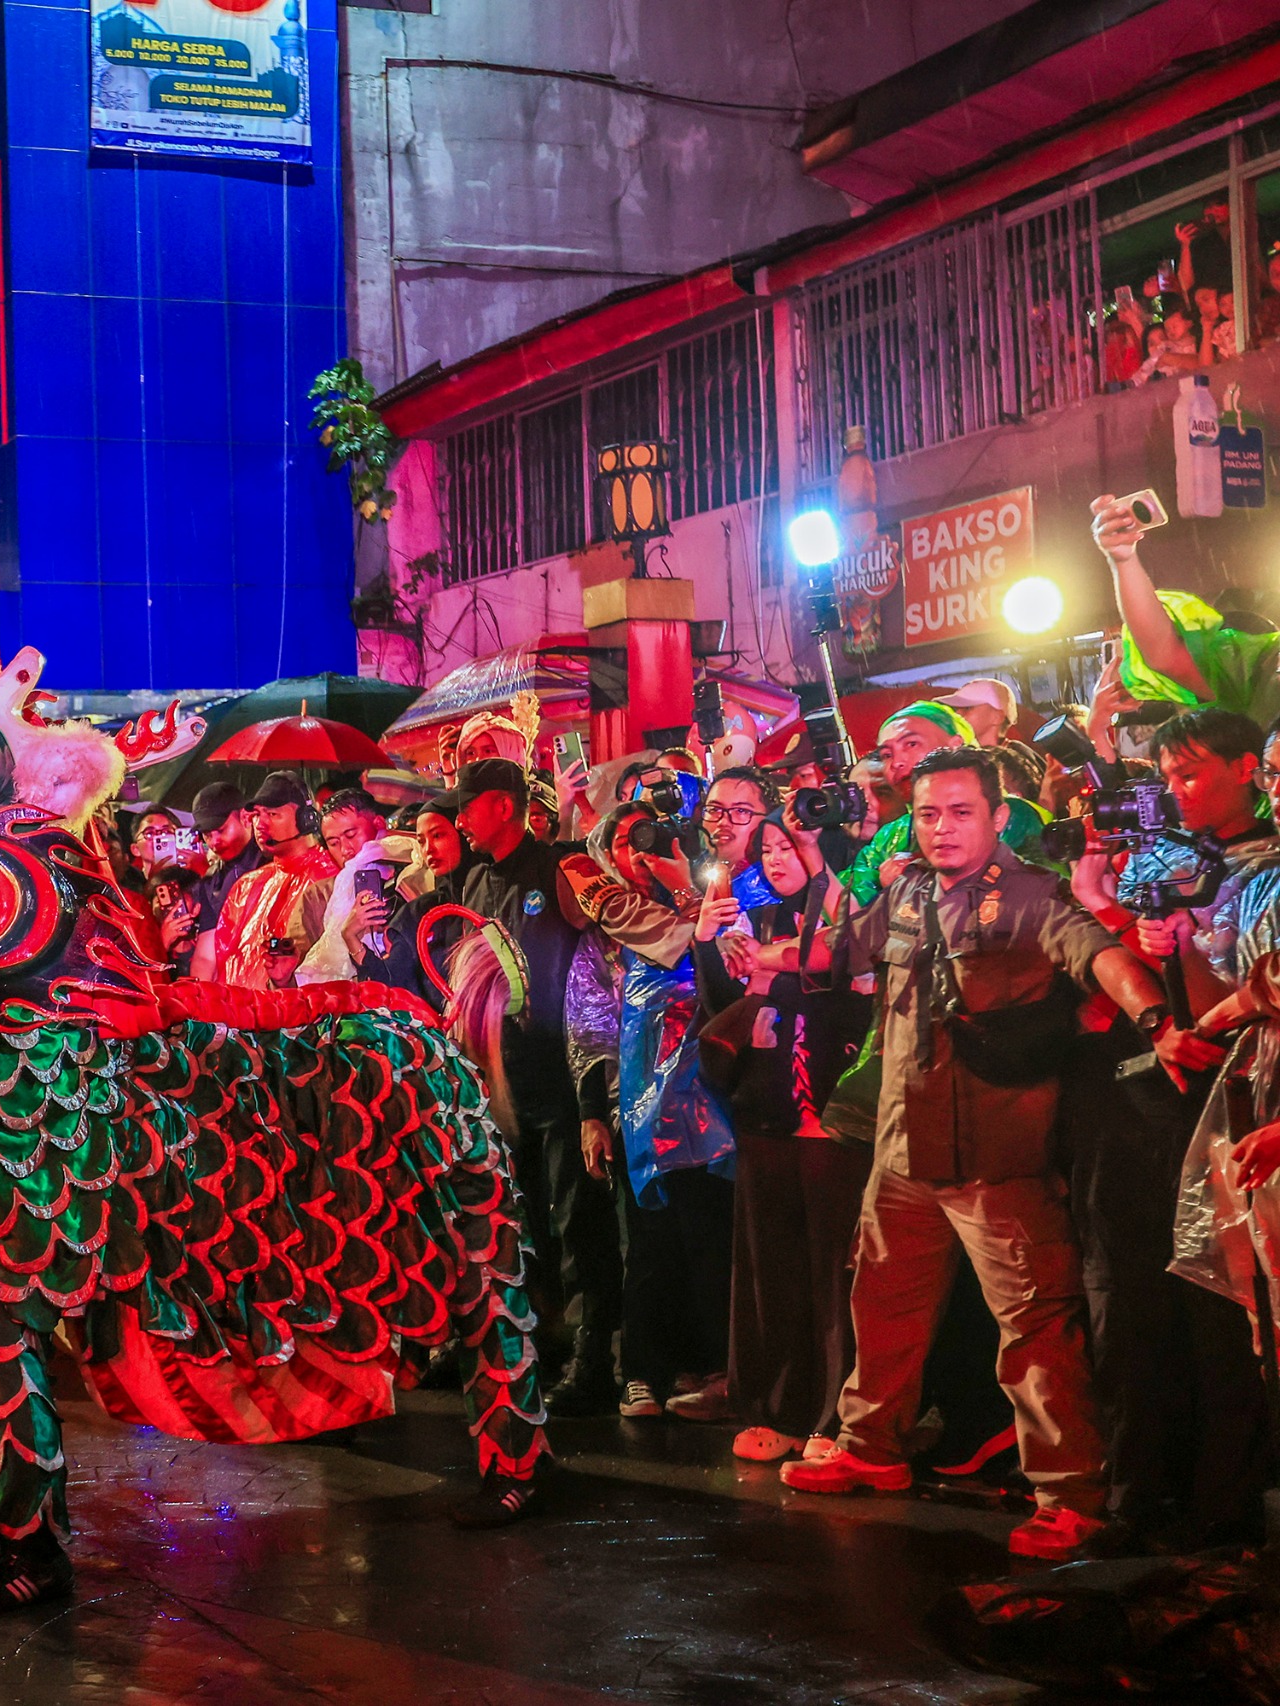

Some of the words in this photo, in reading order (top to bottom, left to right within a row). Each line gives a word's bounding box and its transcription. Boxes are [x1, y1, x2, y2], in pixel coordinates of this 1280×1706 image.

[131, 38, 180, 53] HARGA
[182, 43, 226, 57] SERBA
[105, 49, 134, 59] 5.000
[138, 51, 172, 62] 10.000
[176, 55, 210, 66] 20.000
[214, 58, 248, 69] 35.000
[173, 82, 213, 93] SELAMA
[214, 85, 273, 99] RAMADHAN
[160, 94, 189, 104] TOKO
[190, 96, 220, 107] TUTUP
[221, 99, 248, 110] LEBIH
[249, 101, 287, 113] MALAM
[1191, 419, 1217, 433] AQUA
[1223, 460, 1262, 471] PADANG
[1243, 451, 1260, 461] UNI
[911, 503, 1022, 560] BAKSO
[928, 545, 1006, 593] KING
[840, 571, 890, 596] HARUM
